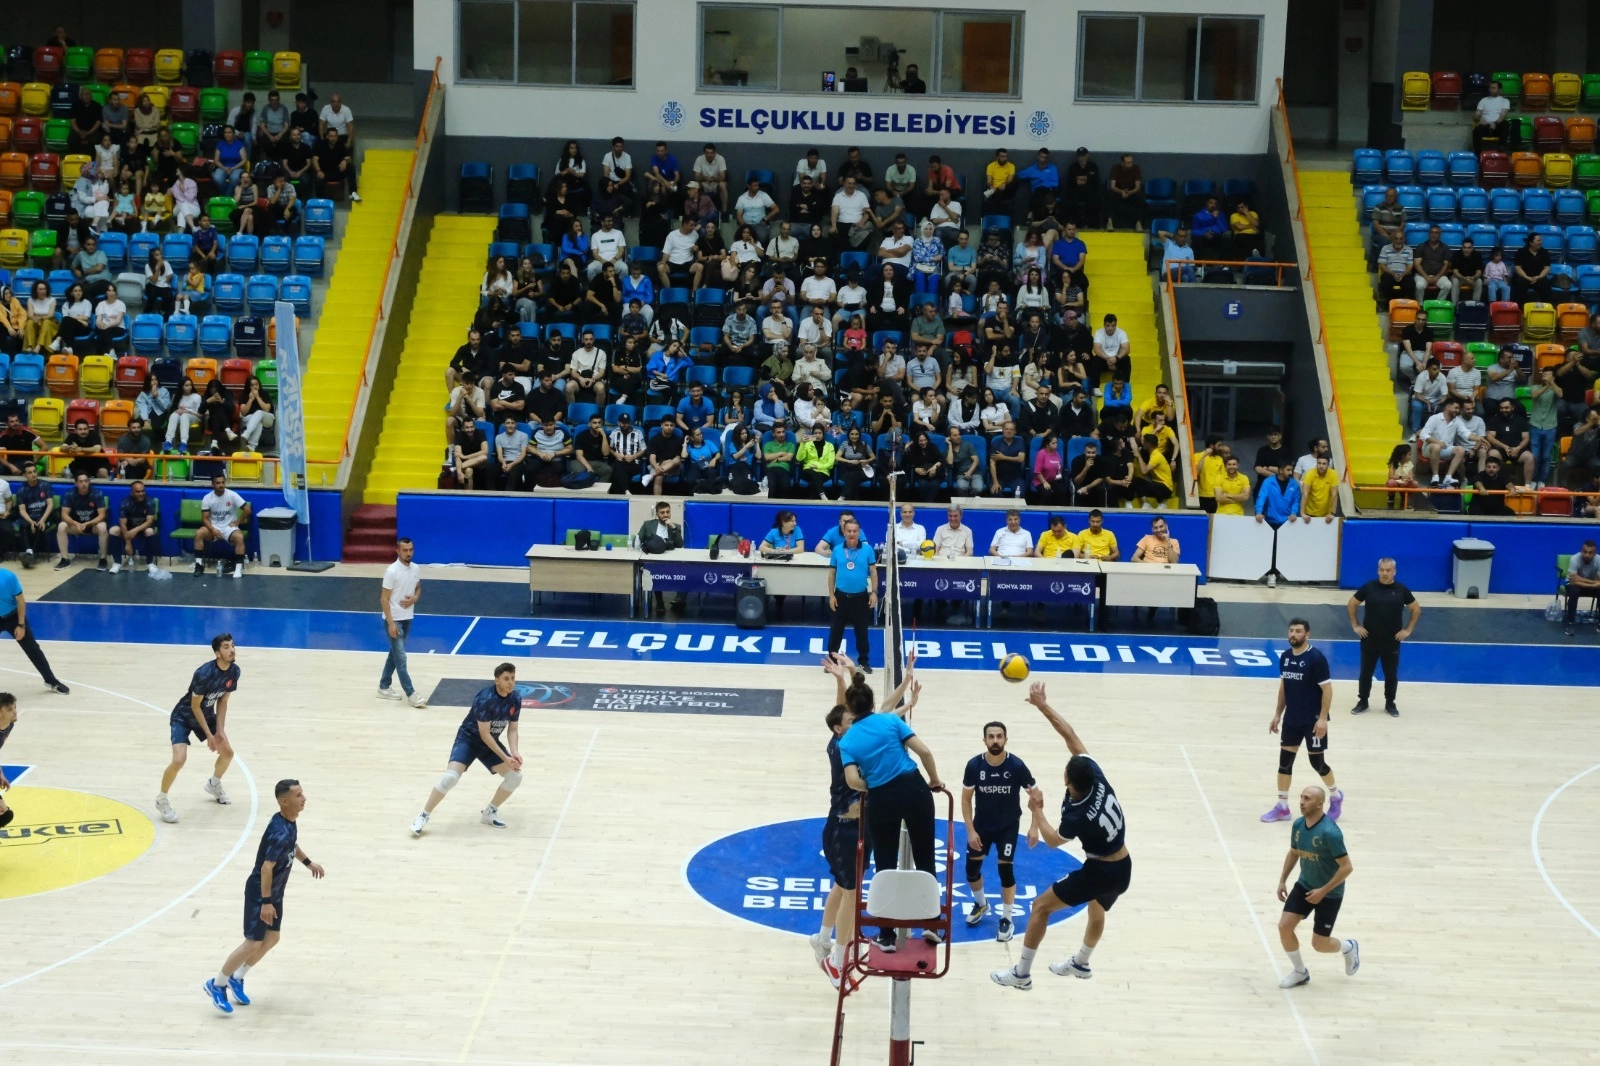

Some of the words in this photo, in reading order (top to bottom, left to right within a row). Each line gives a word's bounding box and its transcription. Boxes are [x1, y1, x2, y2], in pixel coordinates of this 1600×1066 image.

[700, 107, 845, 135] SELÇUKLU
[855, 109, 1016, 136] BELEDİYESİ
[1228, 303, 1239, 315] E
[501, 629, 847, 655] SELÇUKLU
[905, 639, 1284, 668] BELEDİYES
[594, 698, 735, 709] BASKETBOL
[979, 770, 986, 781] 8
[979, 785, 1012, 794] RESPECT
[1098, 793, 1123, 843] 10
[1003, 843, 1013, 857] 8
